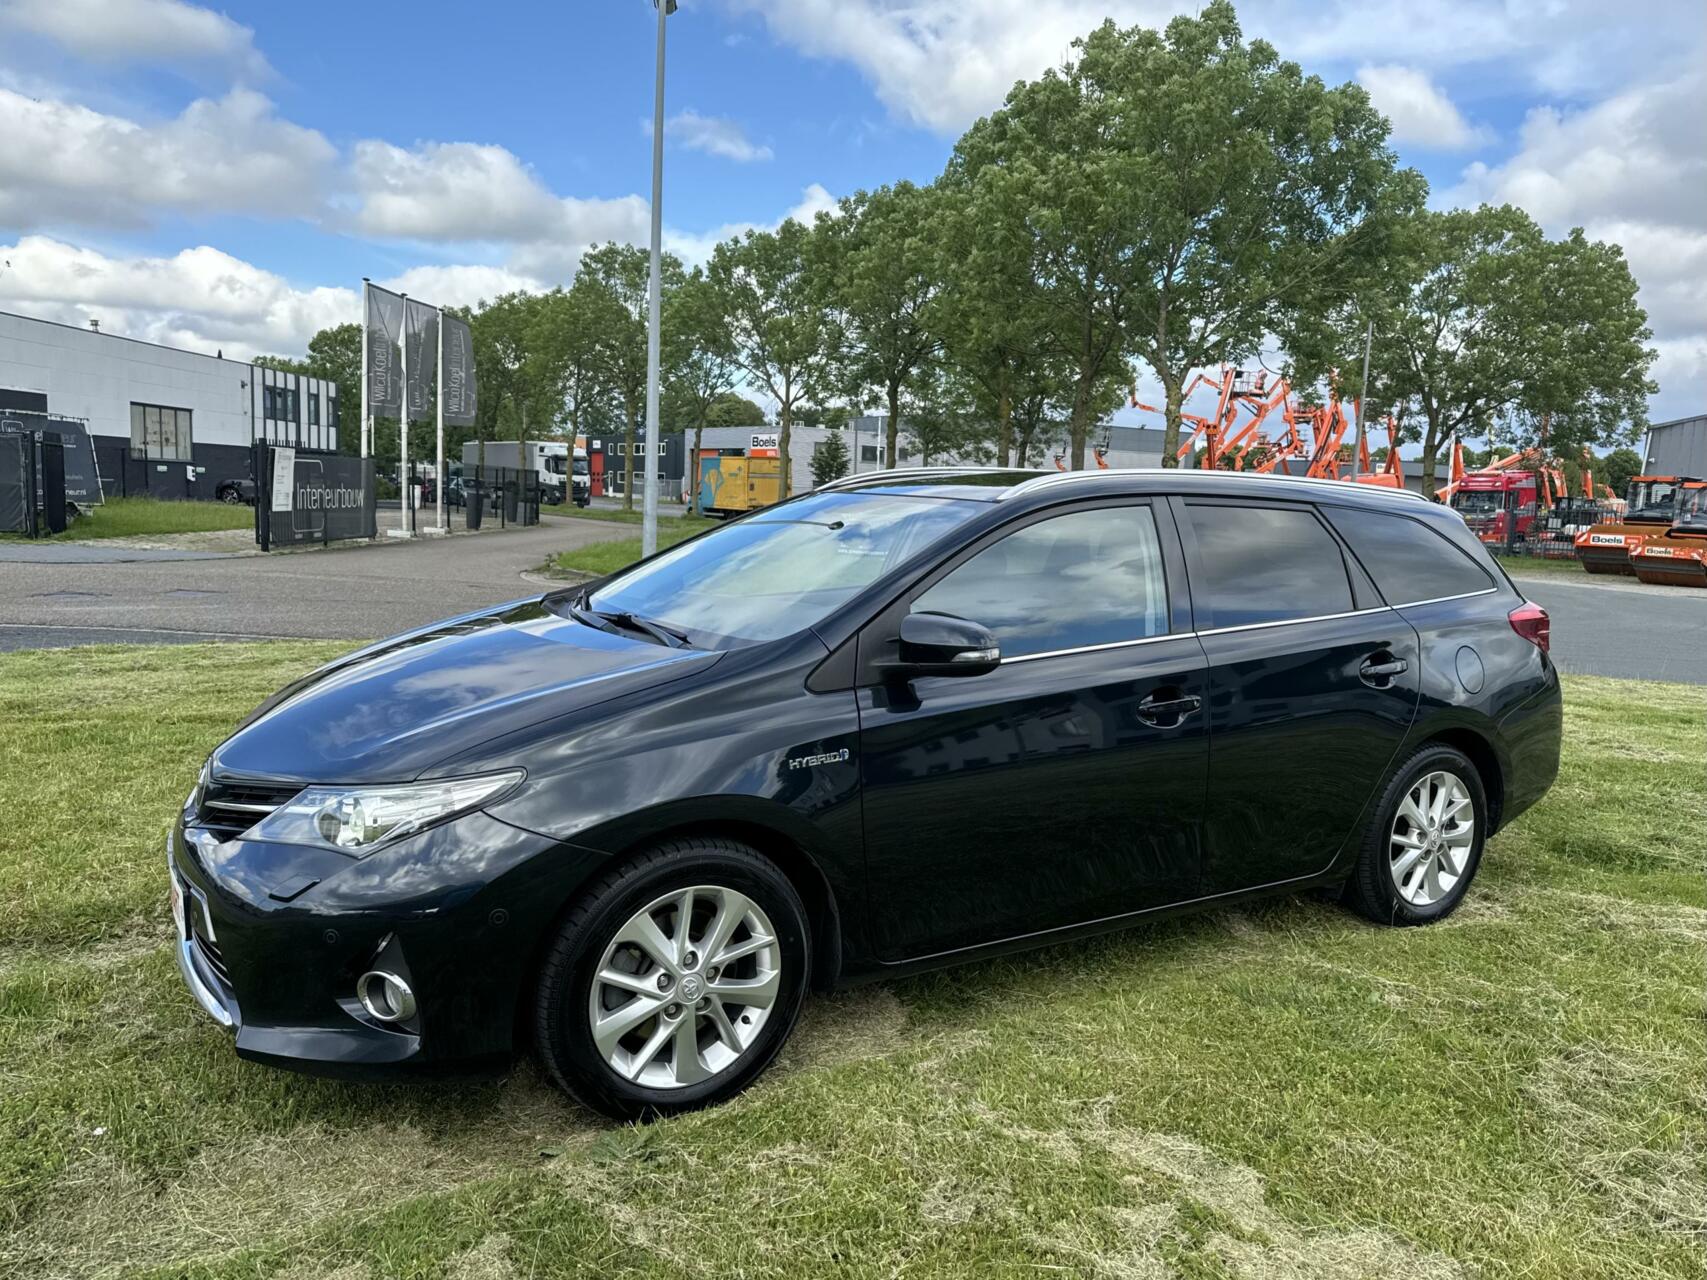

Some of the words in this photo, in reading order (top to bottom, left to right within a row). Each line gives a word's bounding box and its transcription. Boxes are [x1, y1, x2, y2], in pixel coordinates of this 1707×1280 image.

[752, 436, 777, 447] Boels
[296, 481, 365, 510] Interieurbouw
[1592, 535, 1623, 544] Boels
[789, 752, 842, 770] HYBRID
